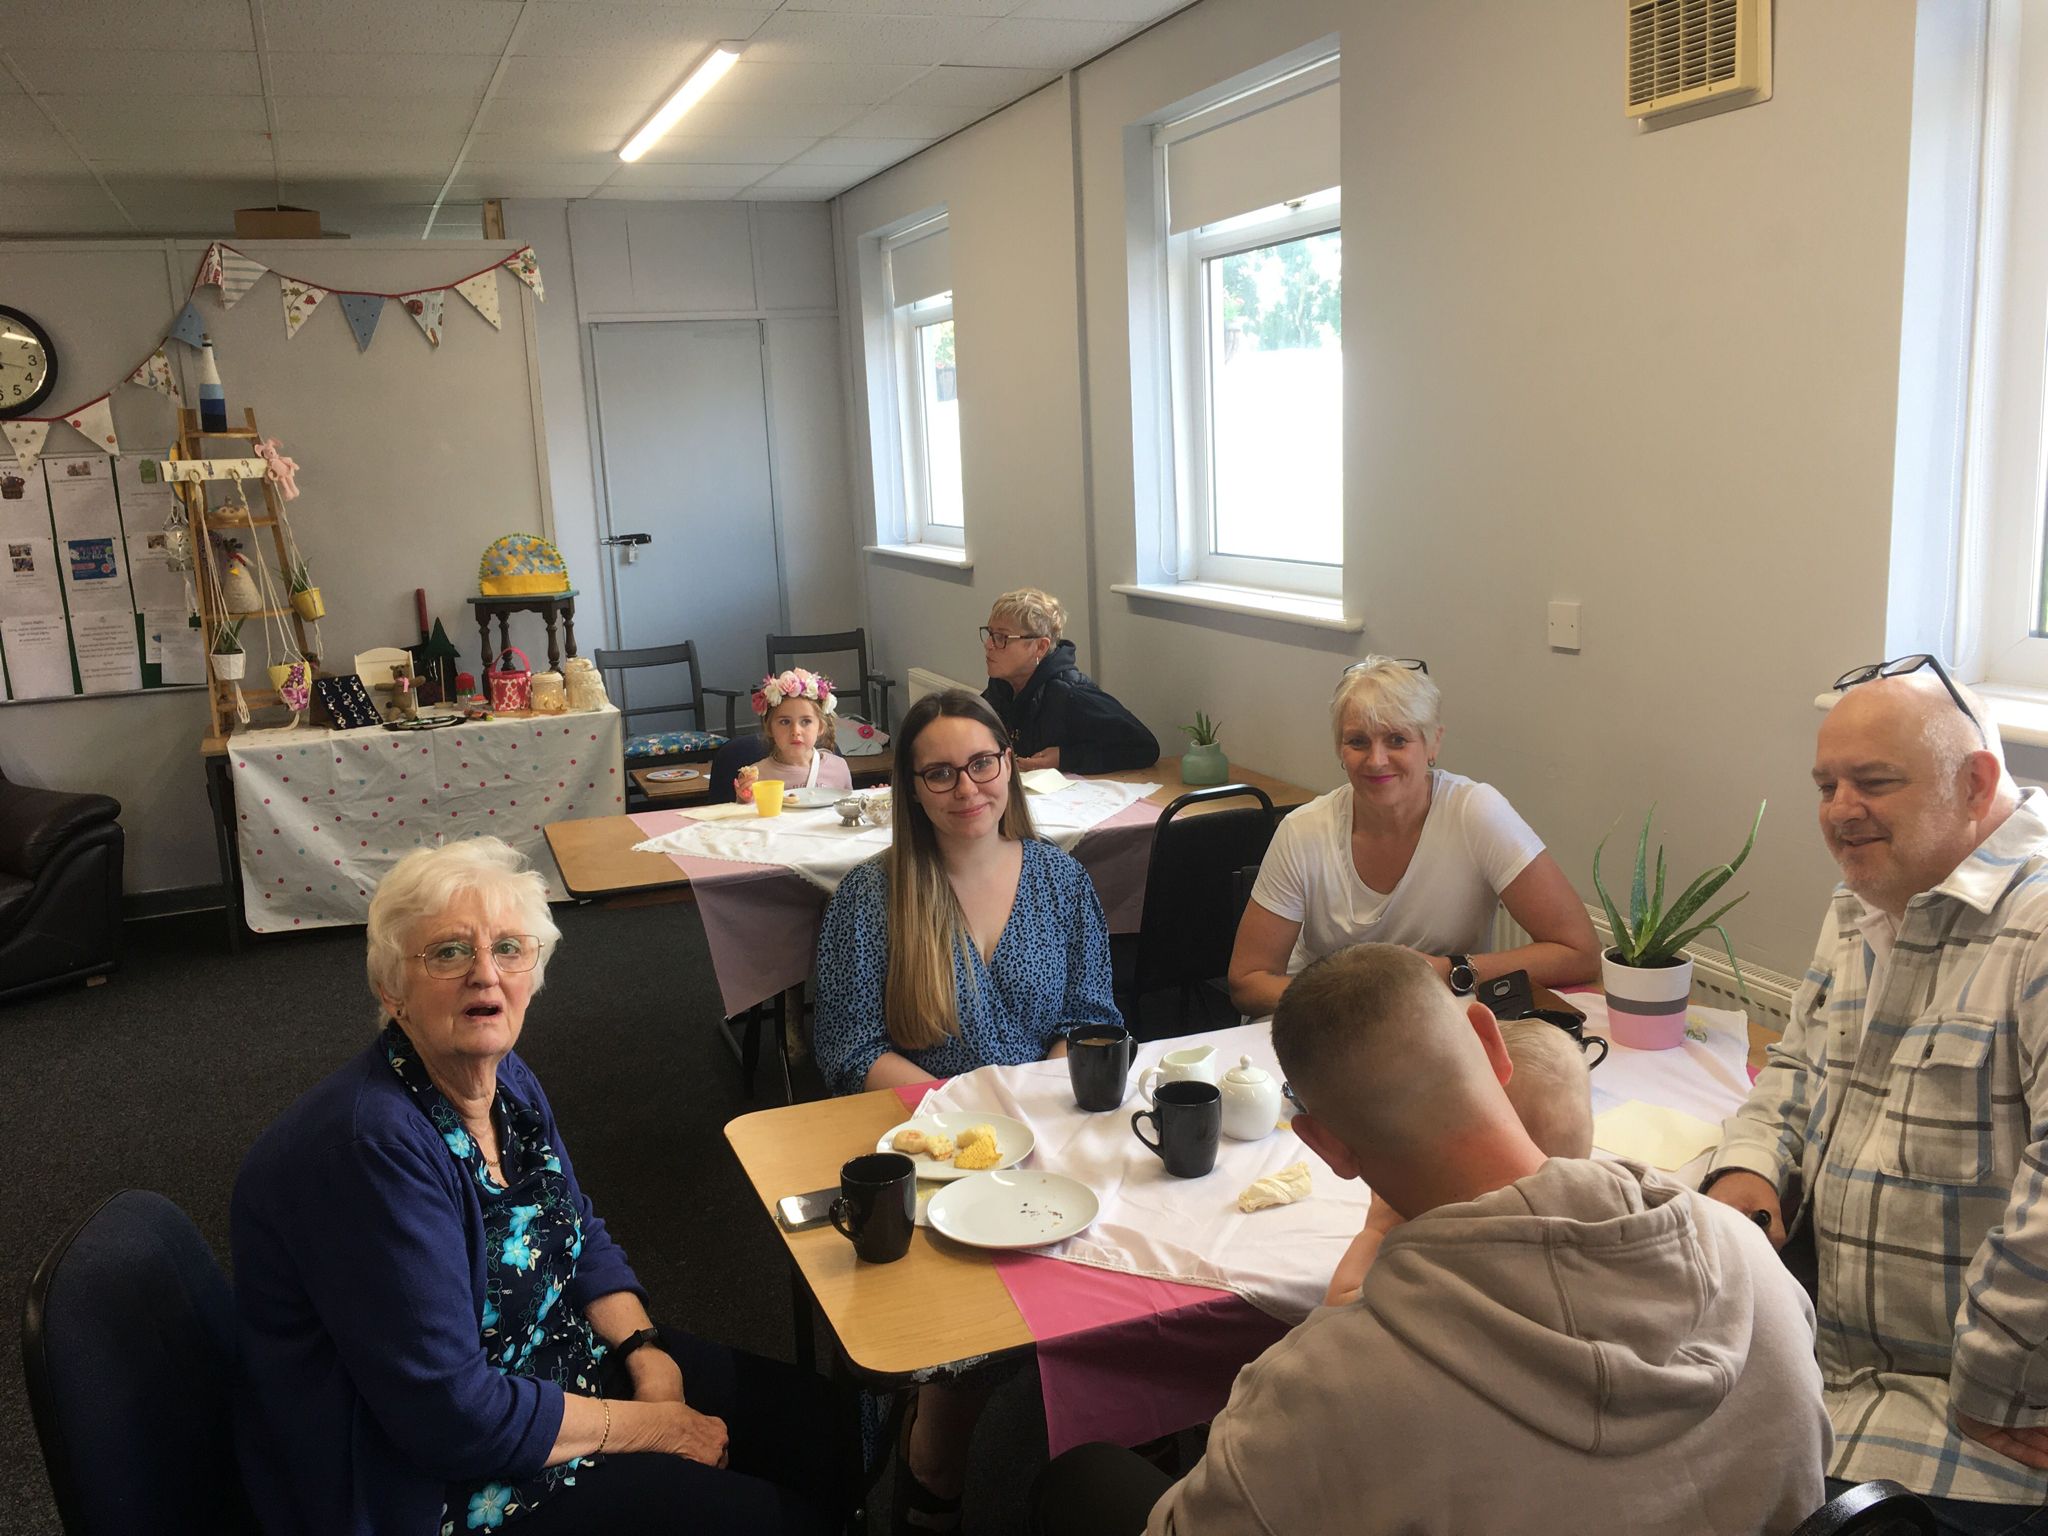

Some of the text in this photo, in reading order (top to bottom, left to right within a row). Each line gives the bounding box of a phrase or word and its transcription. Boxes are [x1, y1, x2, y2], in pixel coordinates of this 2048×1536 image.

[21, 340, 29, 349] 2
[28, 355, 37, 366] 3
[25, 373, 33, 383] 4
[13, 385, 22, 395] 5
